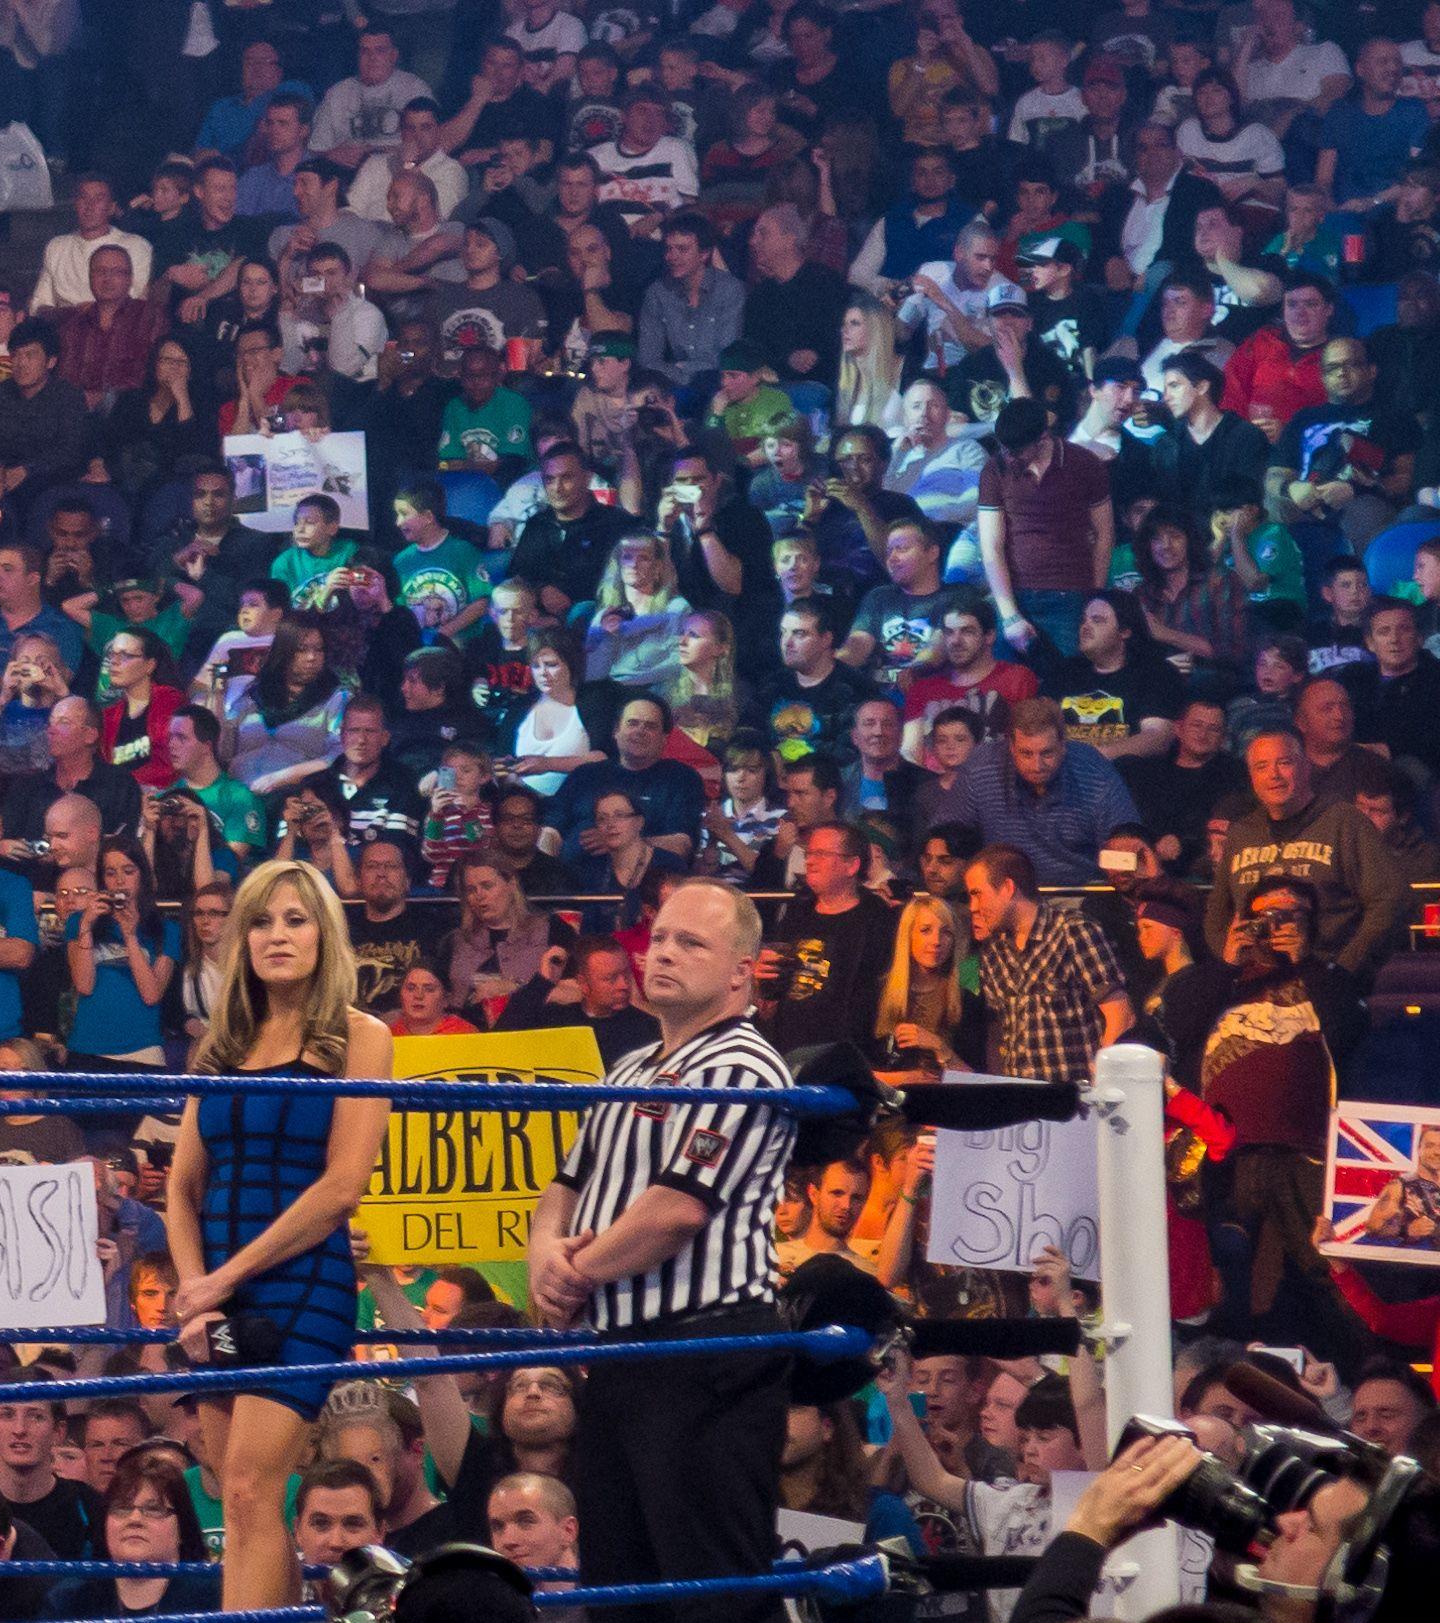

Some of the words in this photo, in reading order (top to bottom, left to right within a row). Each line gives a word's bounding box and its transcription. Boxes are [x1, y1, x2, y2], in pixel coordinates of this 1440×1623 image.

[368, 1072, 588, 1196] ALBERT
[402, 1211, 478, 1251] DEL
[496, 1210, 532, 1248] RI
[951, 1180, 1099, 1276] Sho
